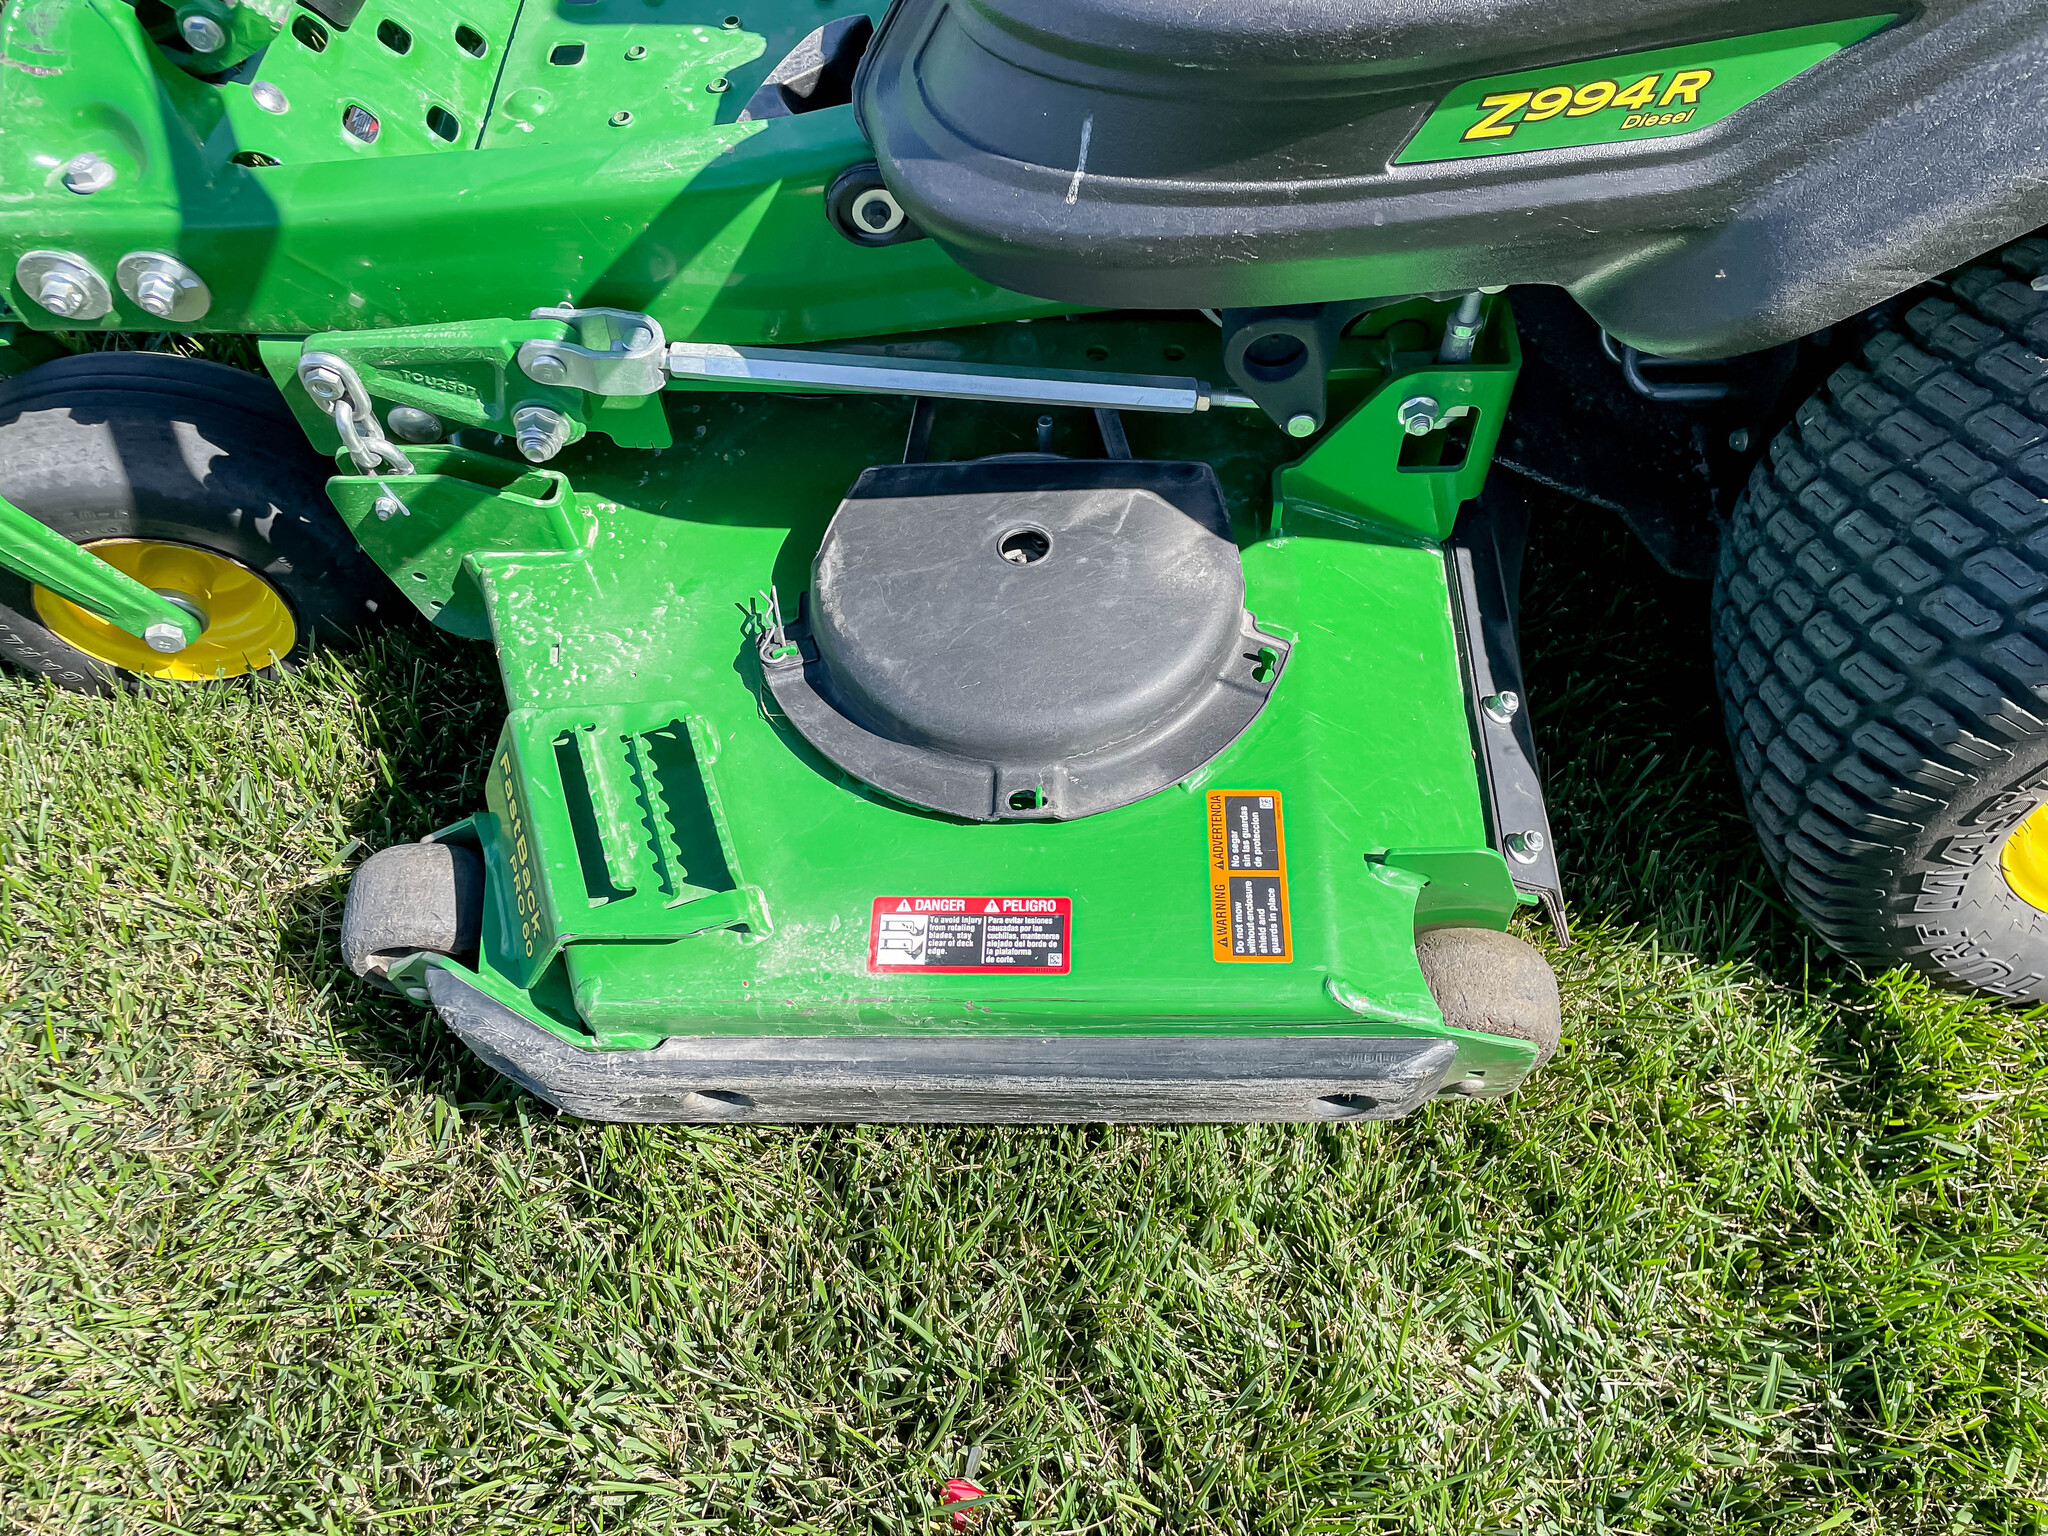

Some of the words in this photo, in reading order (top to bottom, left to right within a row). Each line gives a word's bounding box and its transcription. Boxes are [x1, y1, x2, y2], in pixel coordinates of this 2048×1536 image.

[1461, 68, 1714, 143] Z994R
[1621, 108, 1696, 131] Diesel
[1211, 795, 1223, 859] ADVERTENCIA
[1240, 806, 1249, 838] guardas
[1251, 812, 1263, 854] proteccion
[499, 751, 541, 932] FastBack
[1231, 830, 1240, 853] segar
[1241, 840, 1250, 852] las
[1231, 855, 1240, 867] No
[1243, 854, 1251, 867] sin
[1253, 856, 1262, 867] de
[509, 854, 526, 917] PRO
[522, 920, 534, 958] 60
[915, 900, 965, 911] DANGER
[1003, 900, 1056, 912] PELIGRO
[1245, 881, 1254, 921] enclosure
[1267, 888, 1278, 911] place
[1215, 884, 1227, 935] WARNING
[1235, 902, 1243, 922] mow
[930, 916, 939, 924] To
[940, 916, 960, 924] avoid
[962, 916, 982, 926] injury
[1025, 917, 1053, 925] lesiones
[1257, 909, 1265, 925] and
[1268, 913, 1277, 921] in
[929, 924, 946, 932] from
[948, 924, 975, 933] rotating
[1236, 924, 1244, 939] not
[929, 932, 955, 940] blades,
[957, 933, 972, 941] stay
[947, 939, 955, 947] of
[957, 939, 973, 947] deck
[987, 933, 1019, 941] cuchillas,
[1246, 922, 1256, 953] without
[1258, 927, 1268, 953] shield
[1270, 923, 1281, 954] guards
[987, 940, 1013, 949] alejado
[1236, 941, 1244, 953] Do
[927, 948, 947, 956] edge.
[995, 948, 1031, 957] plataforma
[996, 956, 1016, 964] corte.
[1915, 923, 2045, 998] TURF
